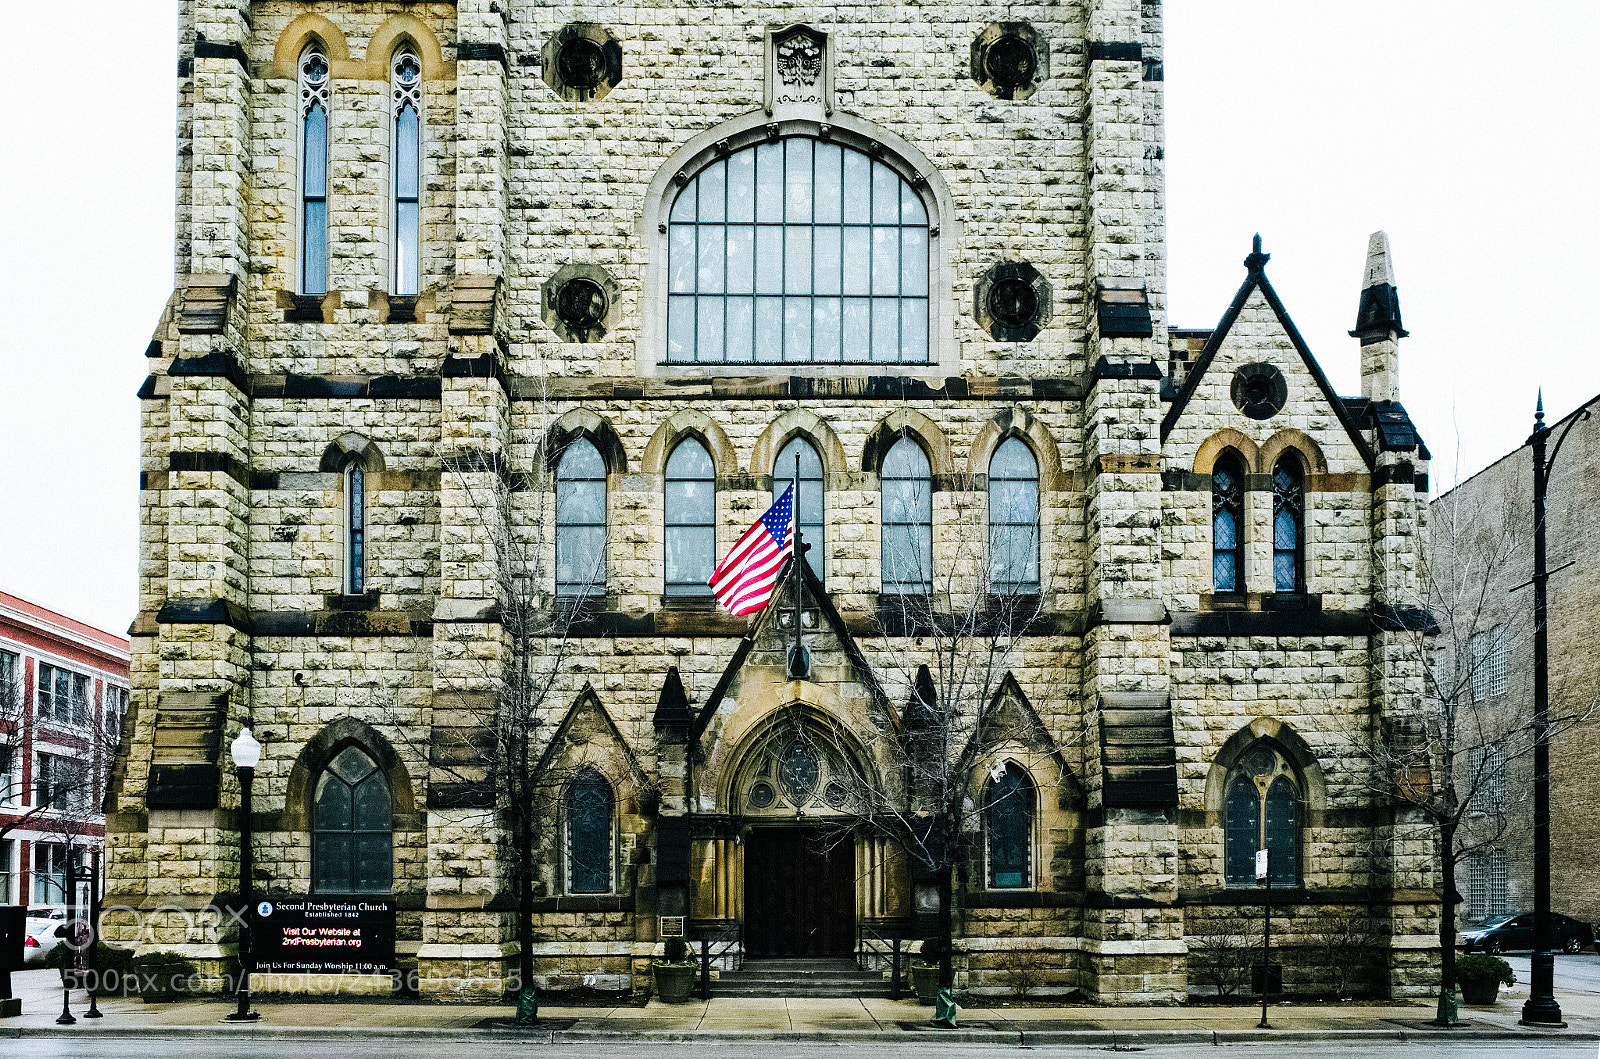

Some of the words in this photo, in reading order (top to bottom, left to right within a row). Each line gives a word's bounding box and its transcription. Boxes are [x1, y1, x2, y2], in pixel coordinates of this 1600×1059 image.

[276, 902, 305, 911] Second
[307, 902, 357, 912] Presbyterian
[358, 902, 388, 911] Church
[282, 927, 300, 936] Visit
[301, 927, 317, 936] Our
[318, 927, 351, 936] Website
[352, 928, 361, 936] at
[282, 937, 361, 947] 2ndPresbyterian.org
[256, 962, 270, 970] Join
[296, 962, 322, 971] Sunday
[324, 962, 353, 971] Worship
